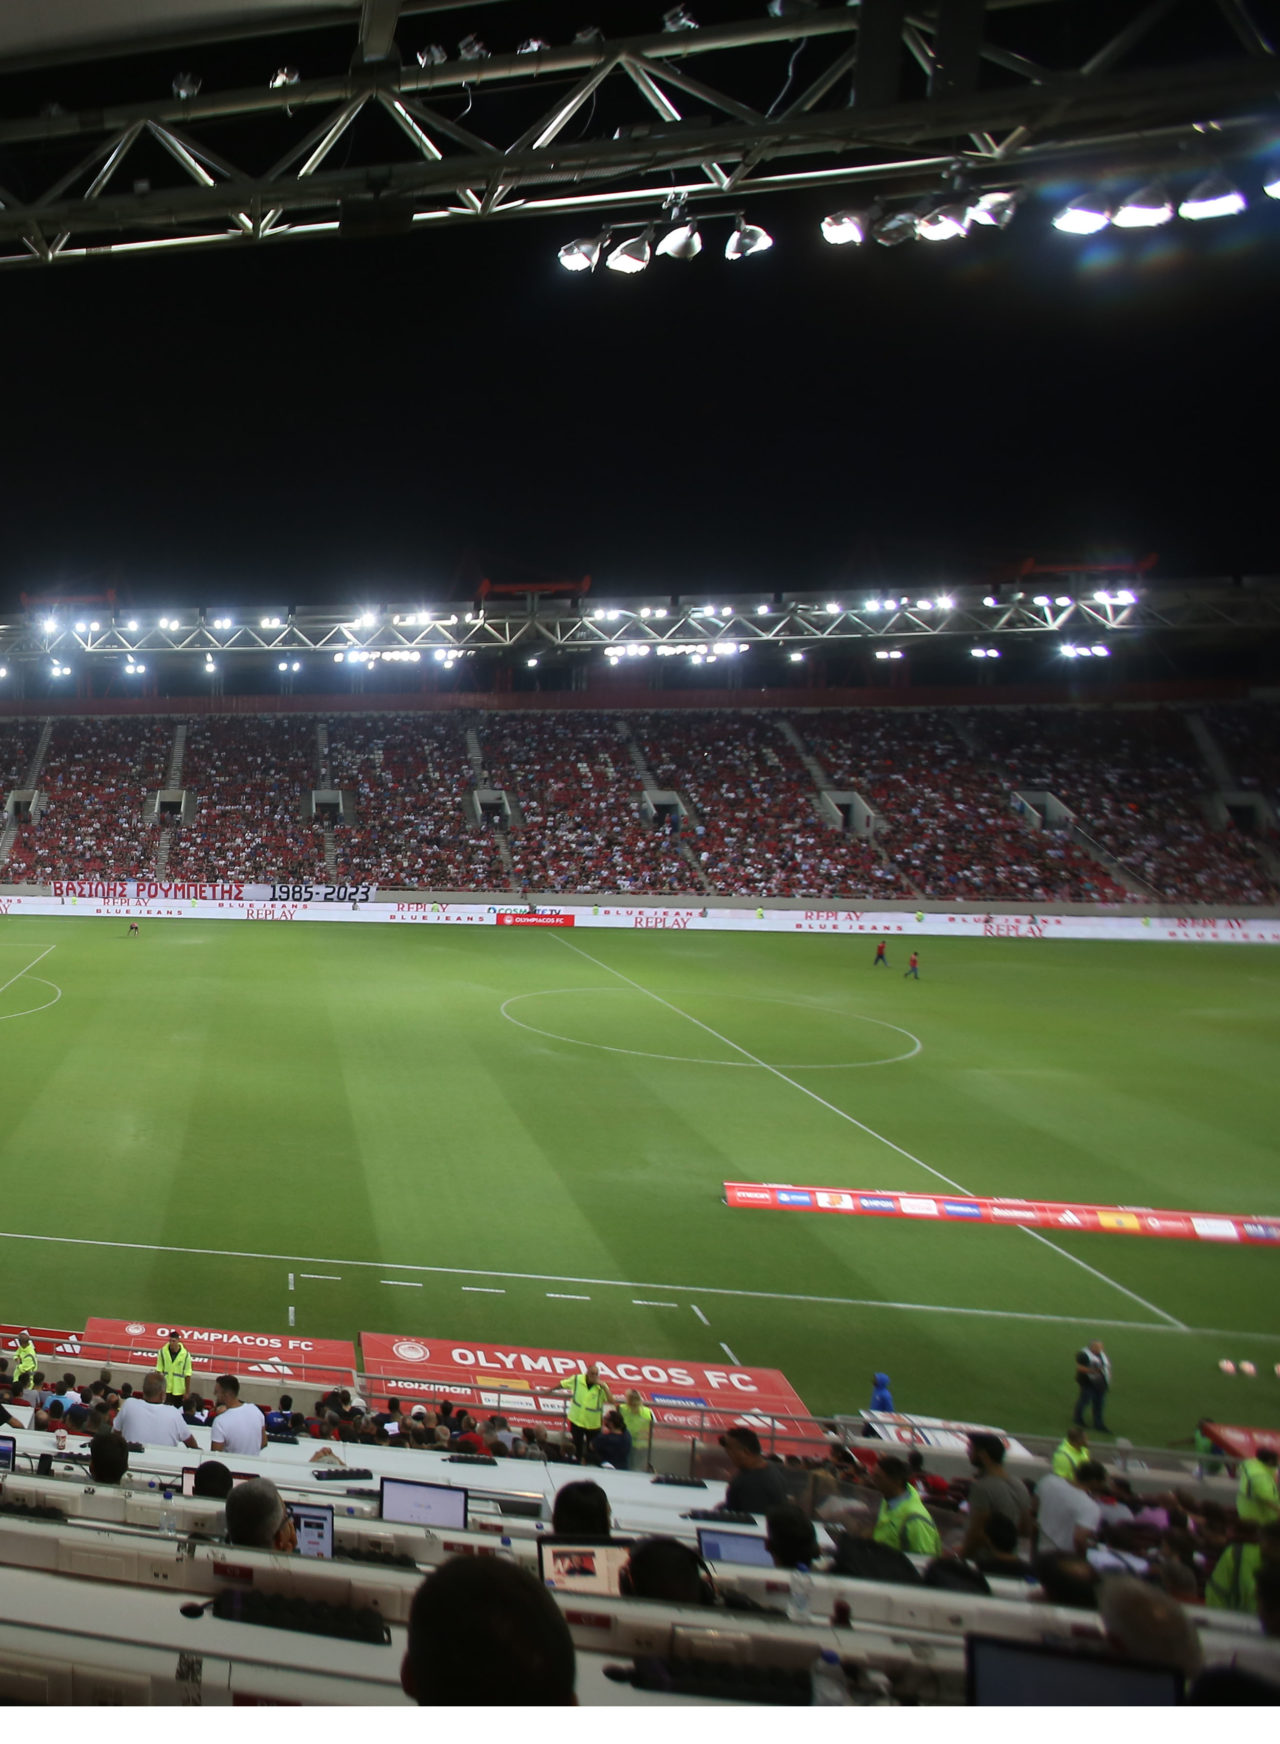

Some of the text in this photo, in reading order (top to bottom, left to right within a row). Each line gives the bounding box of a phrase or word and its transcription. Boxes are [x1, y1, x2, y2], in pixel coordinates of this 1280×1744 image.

[136, 882, 244, 899] ΡΟΥΜΠΕΤΗΣ
[397, 903, 449, 912] REPLY
[246, 909, 297, 920] REPLAY
[634, 917, 690, 928] REPLAY
[984, 924, 1045, 938] REPLAY
[288, 1340, 313, 1351] FC
[451, 1348, 758, 1391] OLYMPIACOS FC
